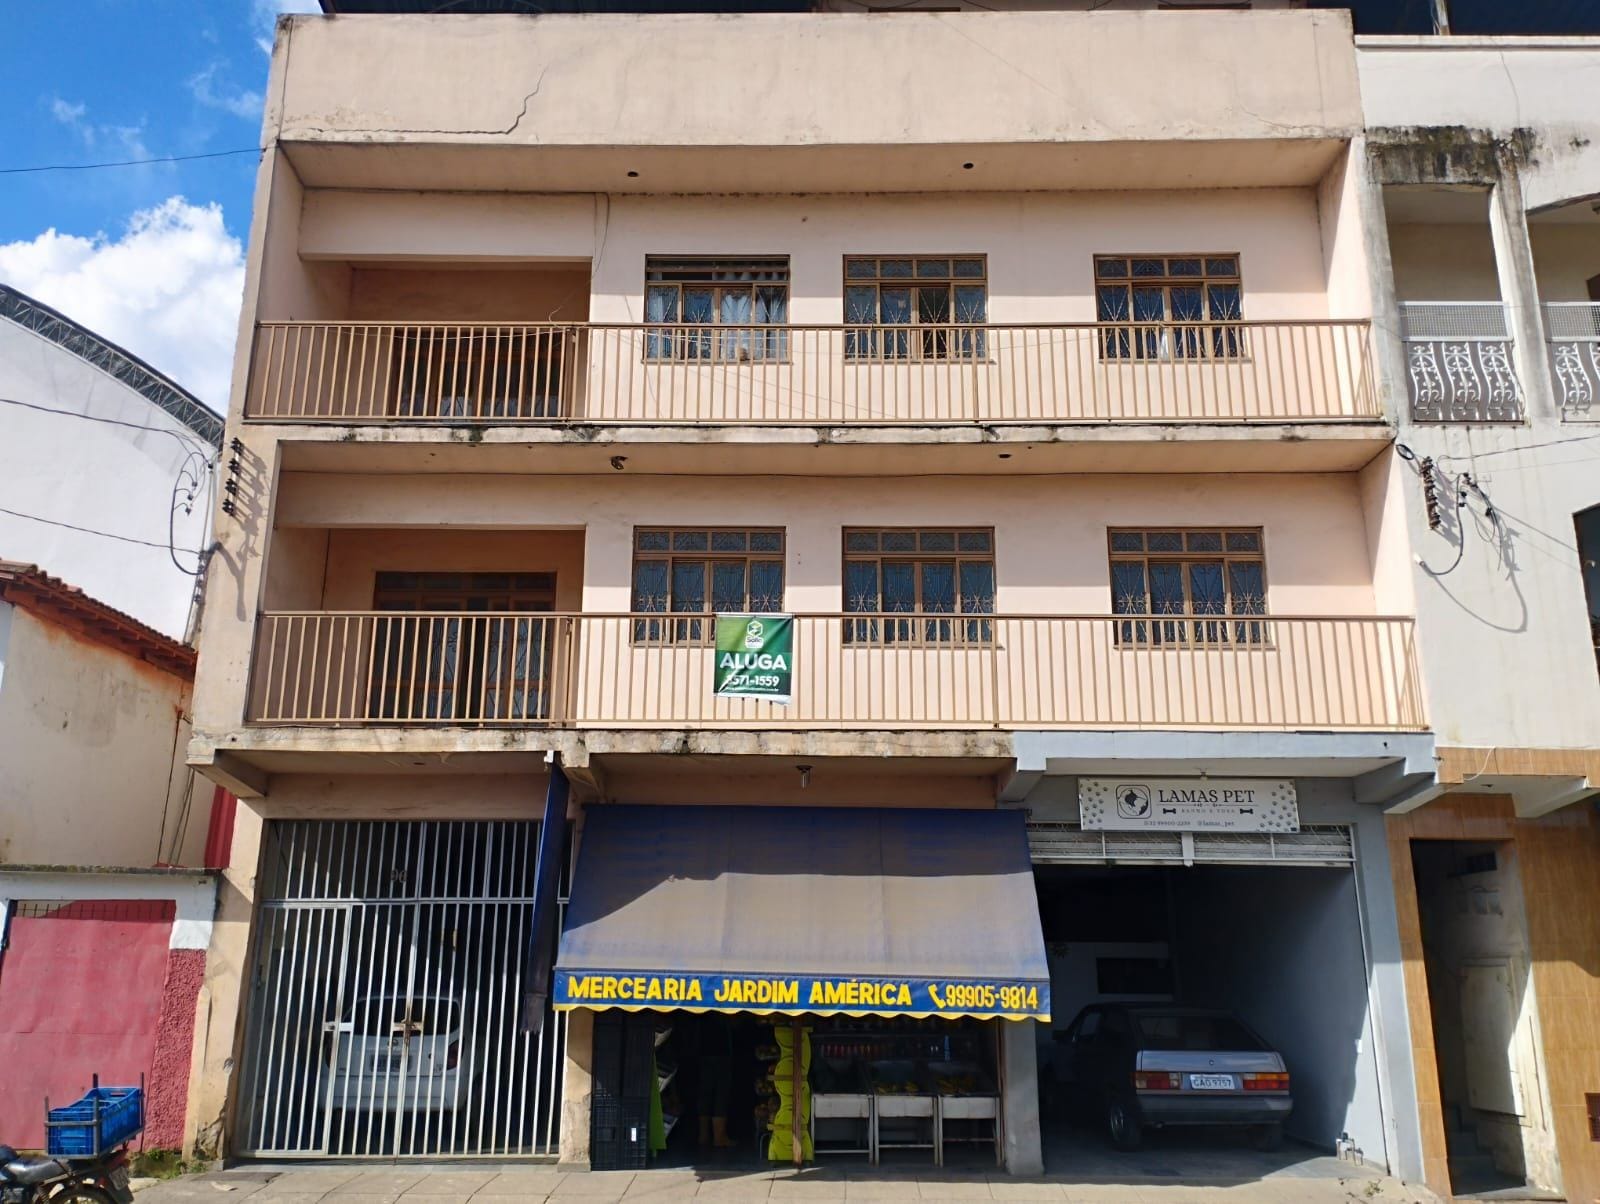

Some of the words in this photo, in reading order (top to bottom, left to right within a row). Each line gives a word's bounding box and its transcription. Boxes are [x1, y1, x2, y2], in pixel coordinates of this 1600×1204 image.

[720, 653, 787, 670] ALUGA
[727, 674, 780, 686] 571-1559
[1158, 789, 1218, 803] LAMAS
[1223, 790, 1255, 803] PET
[567, 976, 702, 1000] MERCEARIA
[714, 979, 799, 1004] JARDIM
[808, 978, 912, 1006] AMÉRICA
